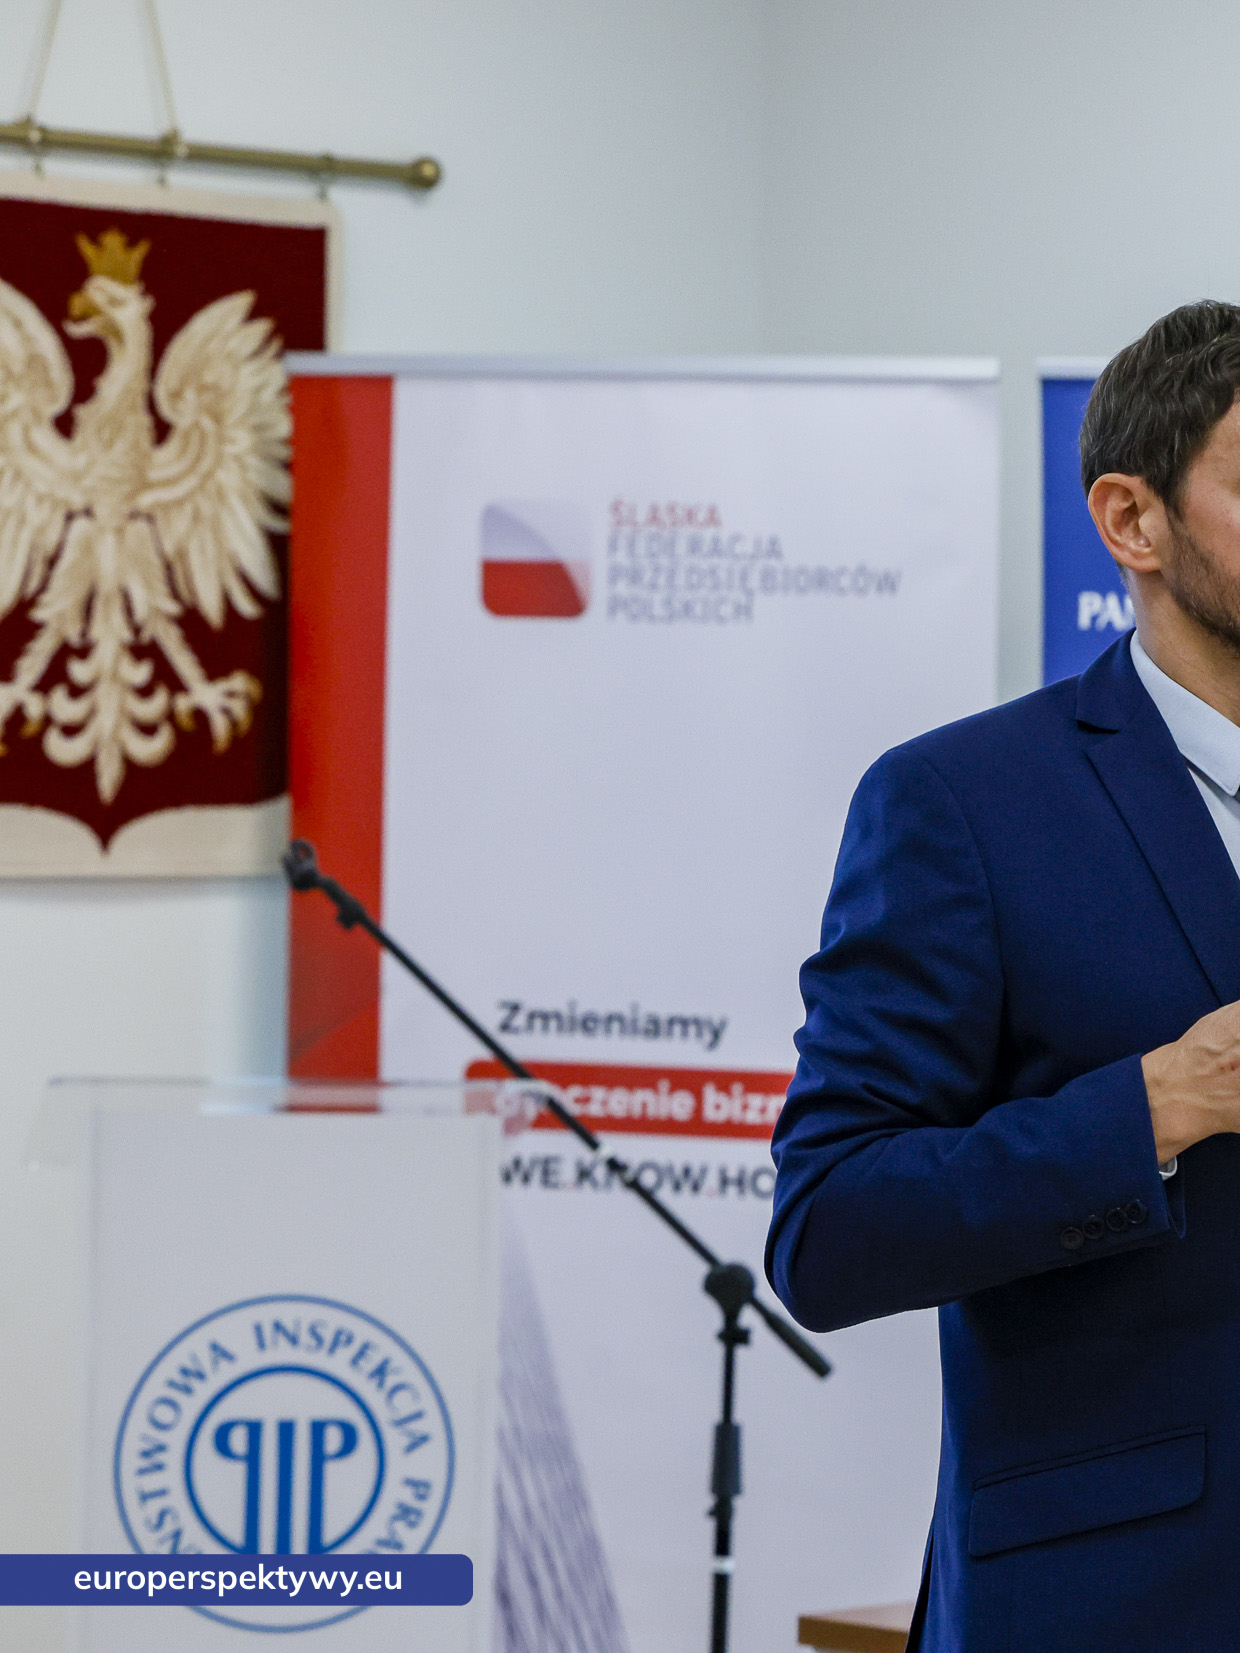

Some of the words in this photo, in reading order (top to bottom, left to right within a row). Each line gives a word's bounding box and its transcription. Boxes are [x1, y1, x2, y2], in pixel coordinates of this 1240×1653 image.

[607, 531, 784, 562] FEDERACJA
[607, 594, 754, 625] POLSKICH
[498, 1000, 727, 1050] Zmieniamy
[252, 1317, 433, 1456] INSPEKCJA
